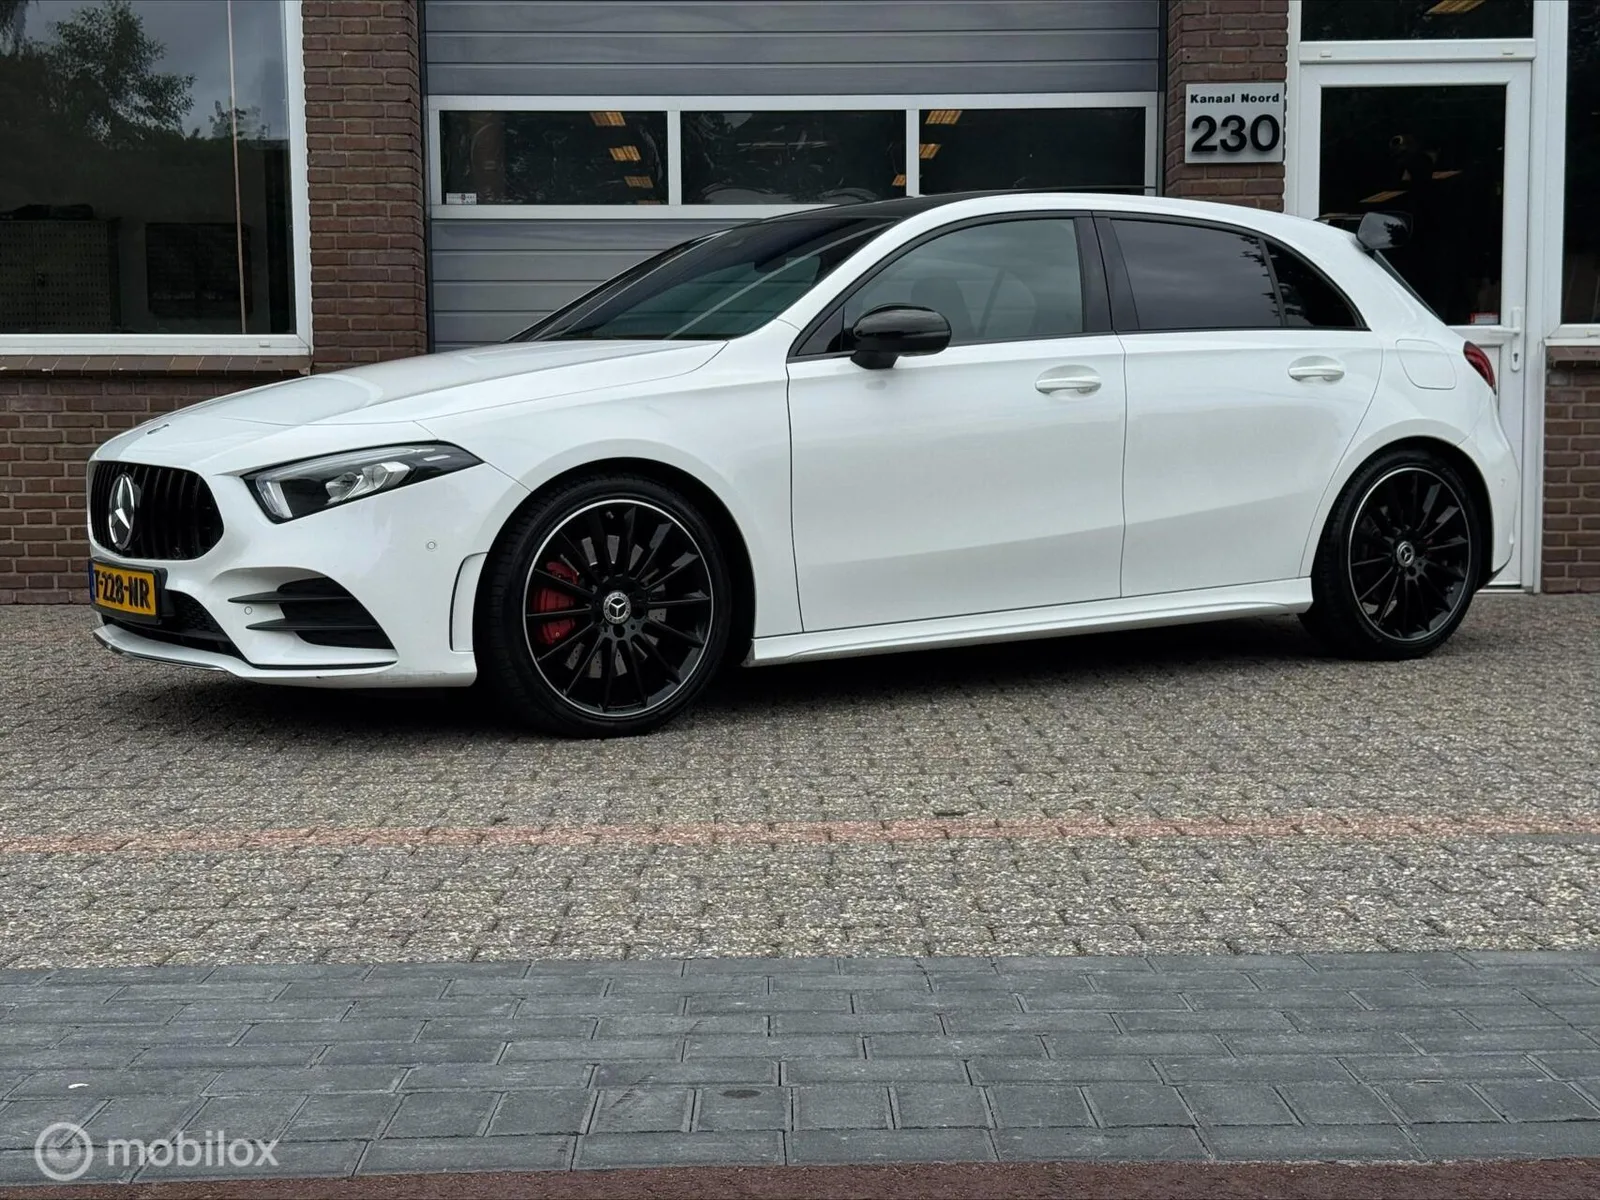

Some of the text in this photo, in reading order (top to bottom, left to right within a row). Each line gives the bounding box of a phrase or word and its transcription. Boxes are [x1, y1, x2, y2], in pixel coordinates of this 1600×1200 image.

[1190, 93, 1280, 103] Kanaal Noord
[1191, 114, 1280, 152] 230
[94, 570, 151, 609] T-228-NR
